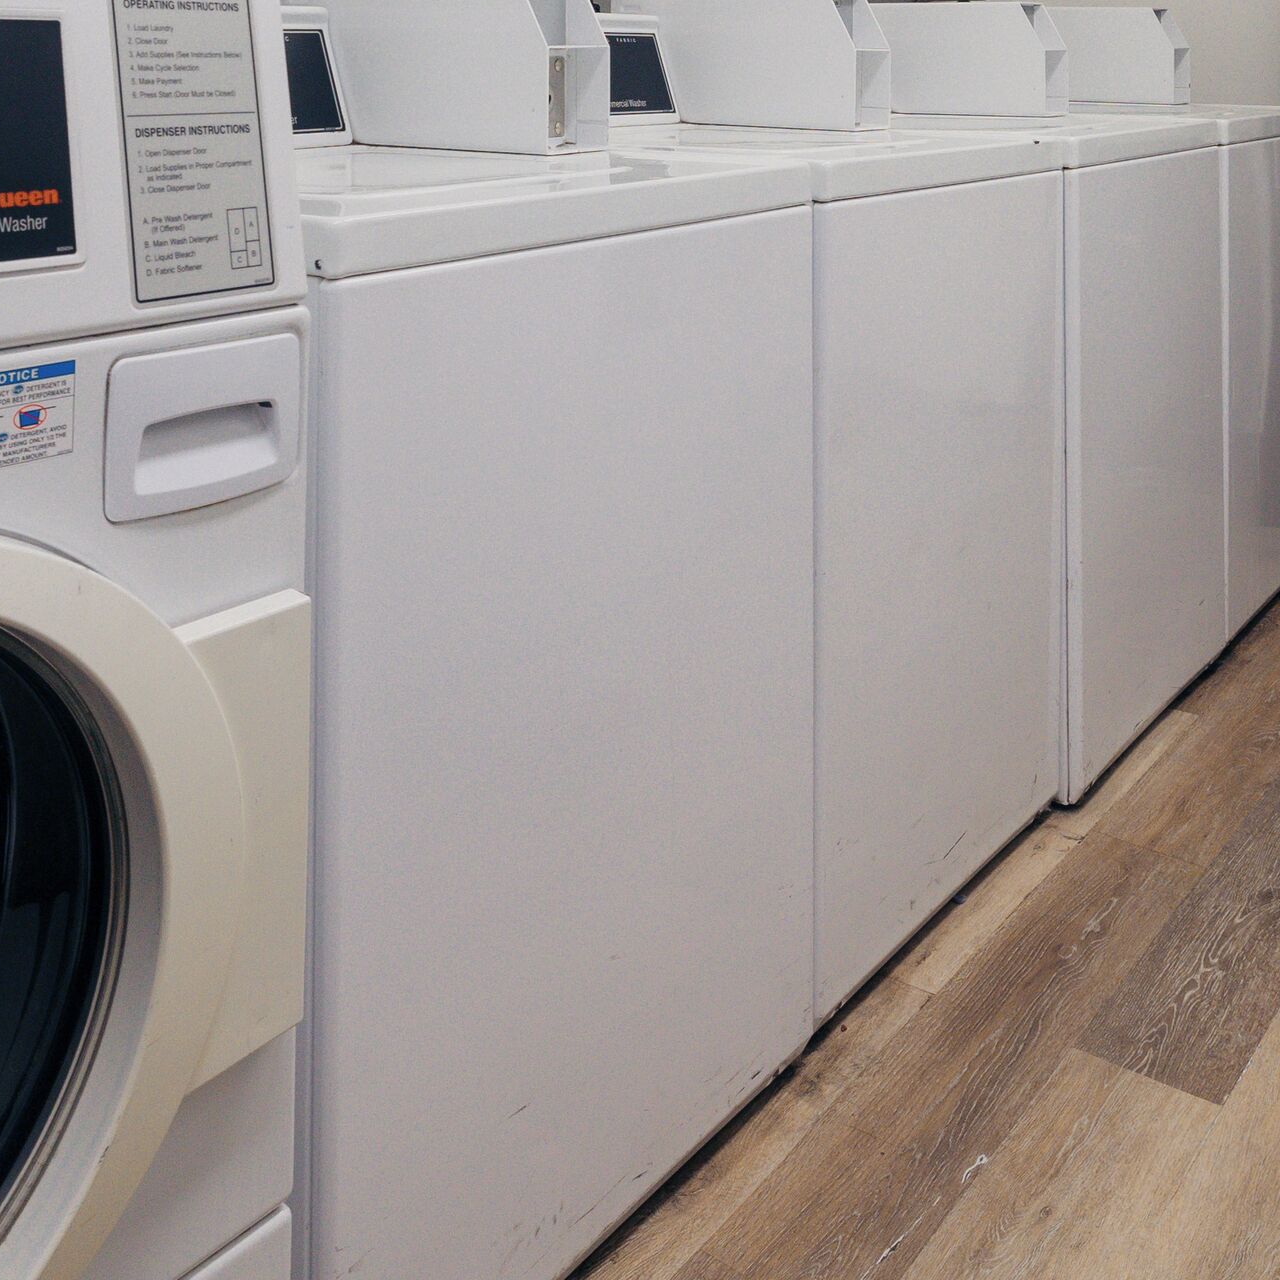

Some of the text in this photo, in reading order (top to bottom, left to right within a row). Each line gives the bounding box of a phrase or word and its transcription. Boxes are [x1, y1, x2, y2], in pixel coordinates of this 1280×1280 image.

[123, 0, 239, 12] OPERATING INSTRUCTIONS
[150, 51, 174, 59] Supplies
[155, 64, 171, 72] Cycle
[156, 78, 182, 86] Payment
[135, 124, 251, 138] DISPENSER INSTRUCTIONS
[145, 150, 161, 158] Open
[163, 149, 191, 157] Dispenser
[163, 163, 187, 172] Supplies
[195, 162, 214, 170] Proper
[215, 160, 252, 168] Compartment
[147, 186, 165, 194] Close
[167, 184, 195, 193] Dispenser
[183, 212, 213, 221] Detergent
[189, 235, 218, 244] Detergent
[154, 253, 173, 262] Liquid
[175, 251, 196, 259] Bleach
[155, 267, 175, 275] Fabric
[177, 264, 202, 273] Softener
[26, 381, 60, 392] DETERGENT
[12, 395, 26, 403] BEST
[28, 388, 70, 400] PERFORMANCE
[49, 424, 67, 433] AVOID
[8, 439, 27, 449] USING
[29, 436, 45, 445] ONLY
[21, 451, 47, 461] AMOUNT
